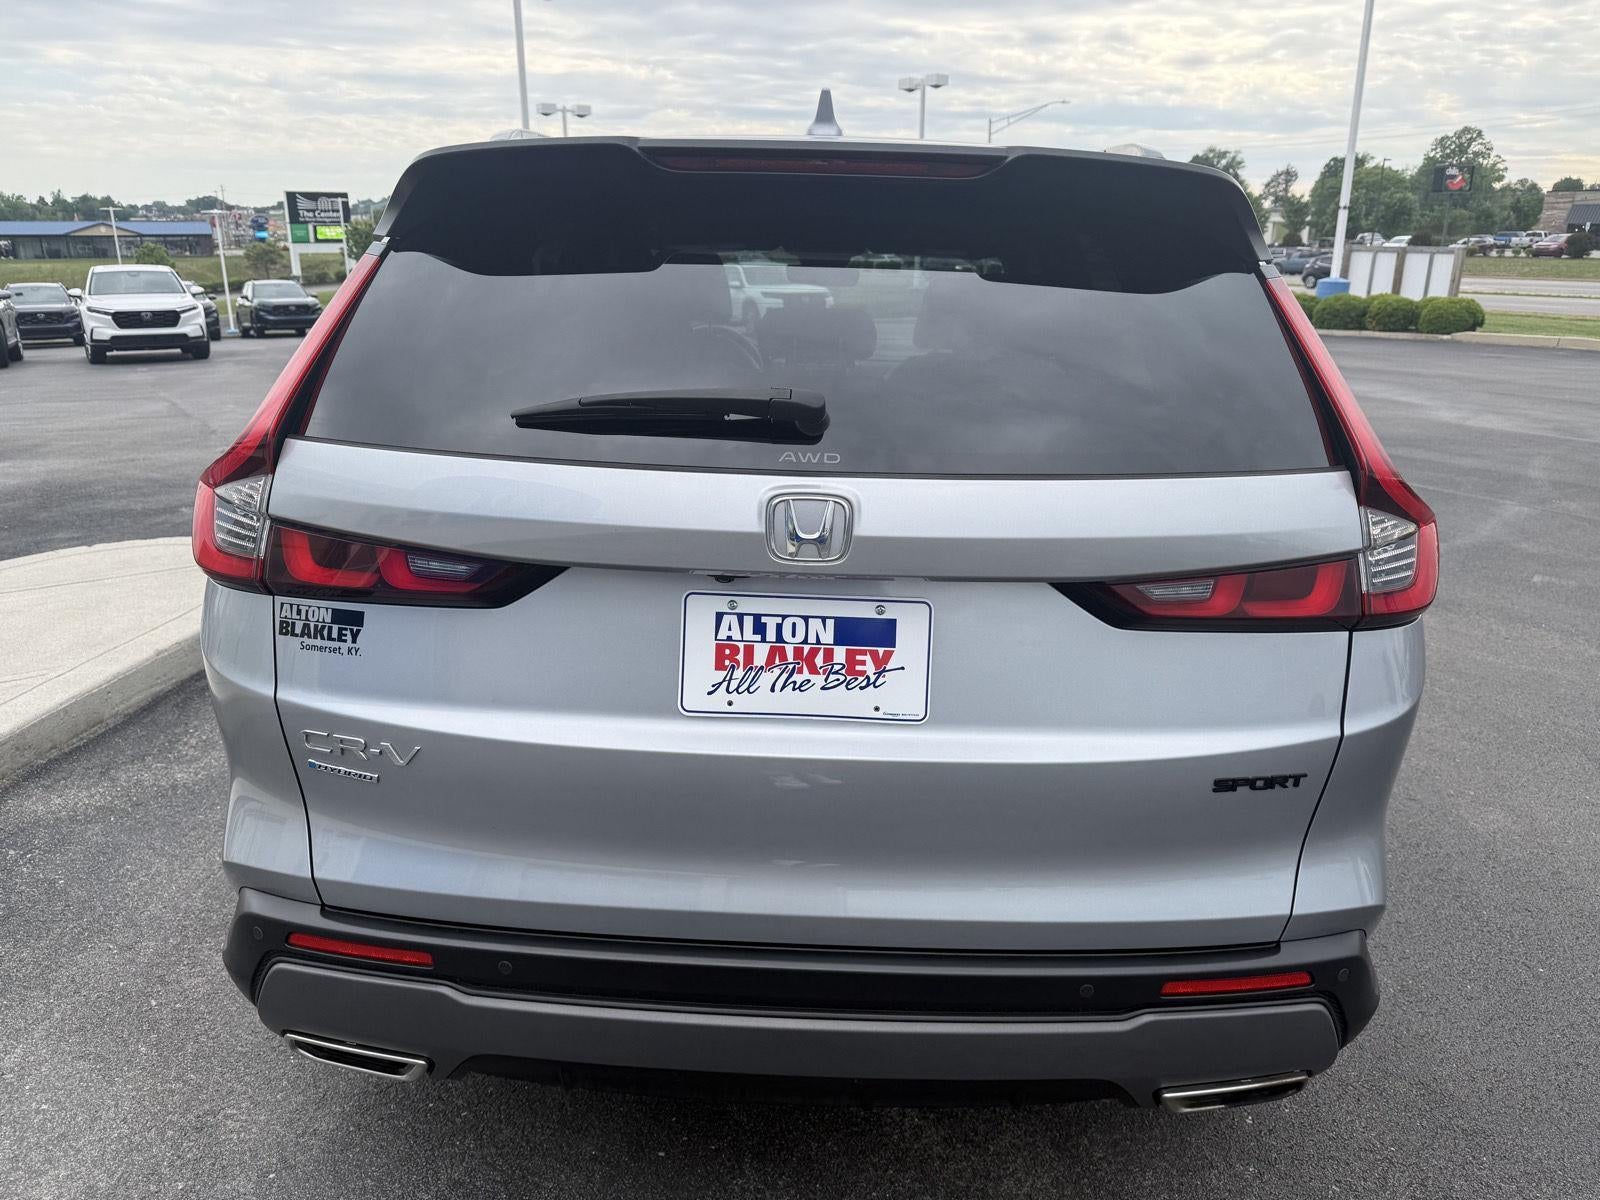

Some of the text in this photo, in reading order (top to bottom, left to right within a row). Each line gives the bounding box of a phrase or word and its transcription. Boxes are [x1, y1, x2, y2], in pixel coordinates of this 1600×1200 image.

[298, 210, 314, 218] The
[778, 451, 841, 464] AWD
[280, 603, 333, 623] ALTON
[278, 619, 362, 644] BLAKLEY
[716, 613, 835, 645] ALTON
[299, 640, 362, 657] Somerset, KY.
[714, 642, 896, 678] BLAKLEY
[706, 661, 906, 696] All The Best
[300, 729, 422, 767] CR-V
[316, 763, 375, 782] HYBRID
[1211, 772, 1309, 793] SPORT
